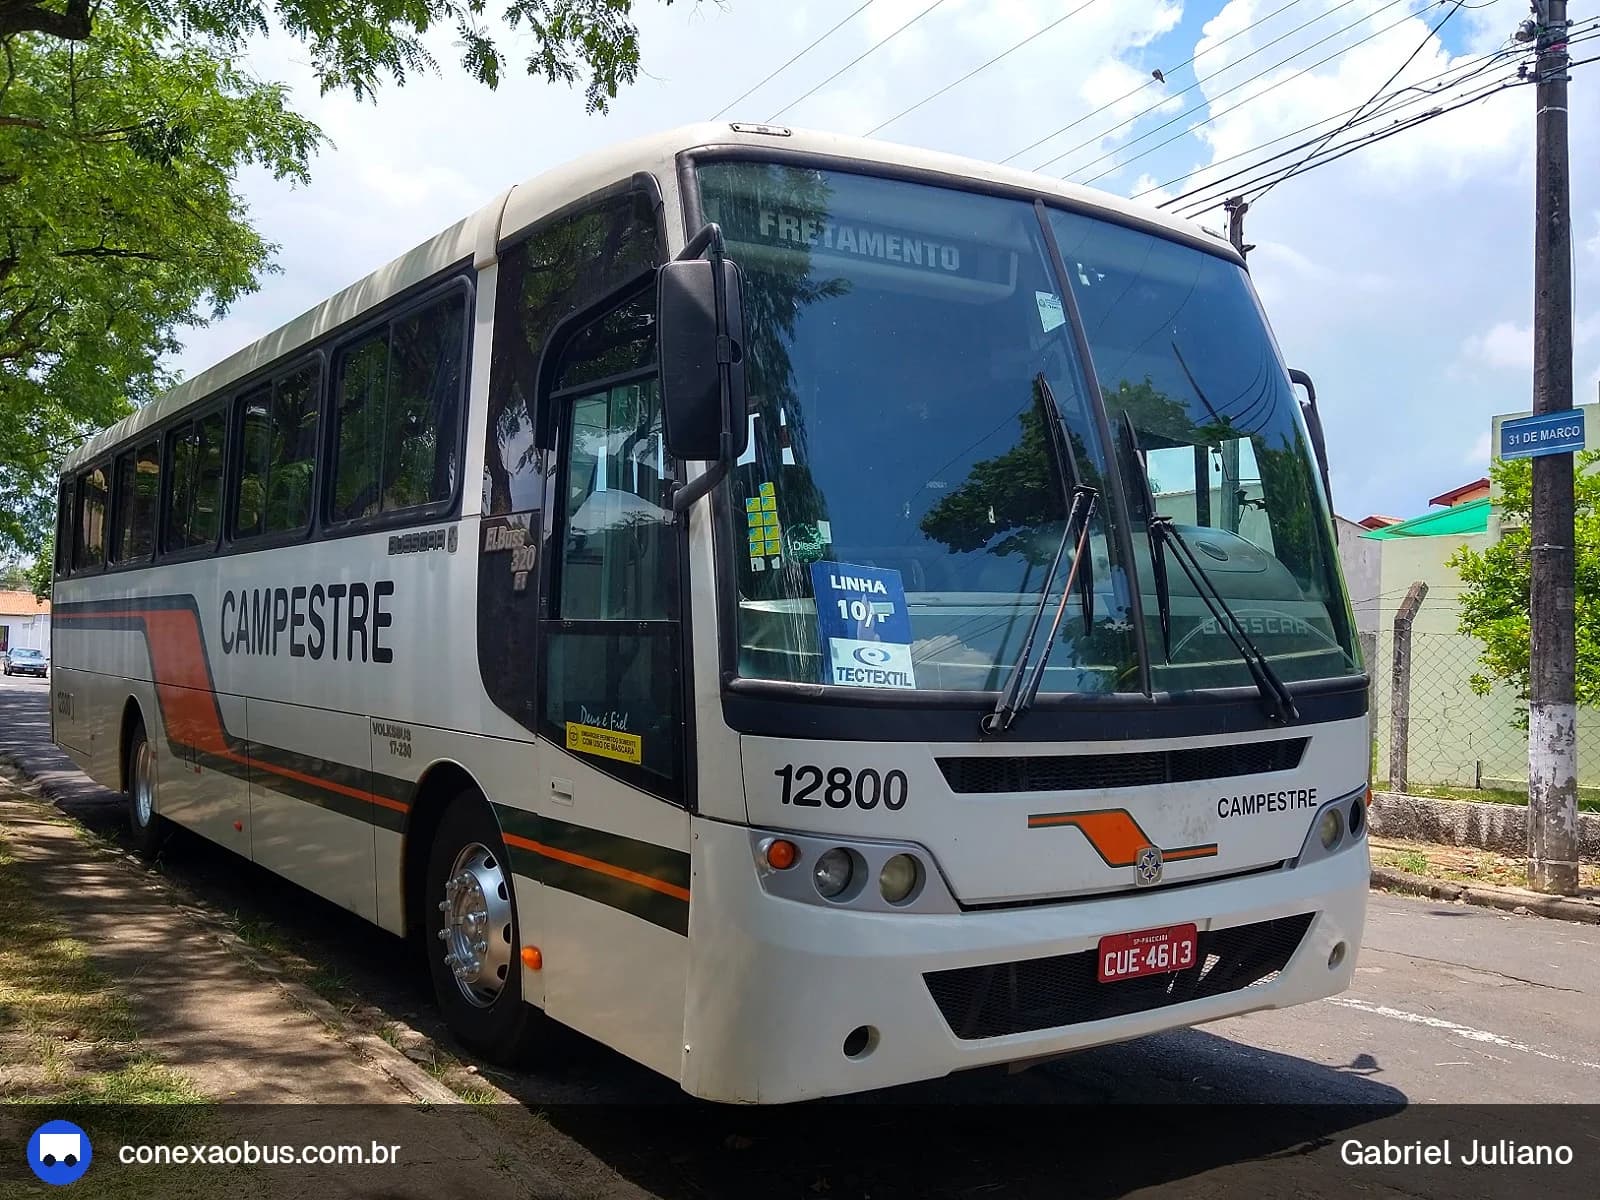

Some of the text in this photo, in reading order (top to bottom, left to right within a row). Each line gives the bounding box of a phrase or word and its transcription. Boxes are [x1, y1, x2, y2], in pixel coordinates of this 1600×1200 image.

[759, 210, 960, 271] FRETAMENTO
[1508, 425, 1580, 445] 31 DE MARÇO
[510, 545, 537, 572] 320
[830, 575, 887, 595] LINHA
[221, 581, 394, 664] CAMPESTRE
[836, 666, 912, 687] TECTEXTIL
[774, 764, 908, 811] 12800
[1217, 788, 1318, 819] CAMPESTRE
